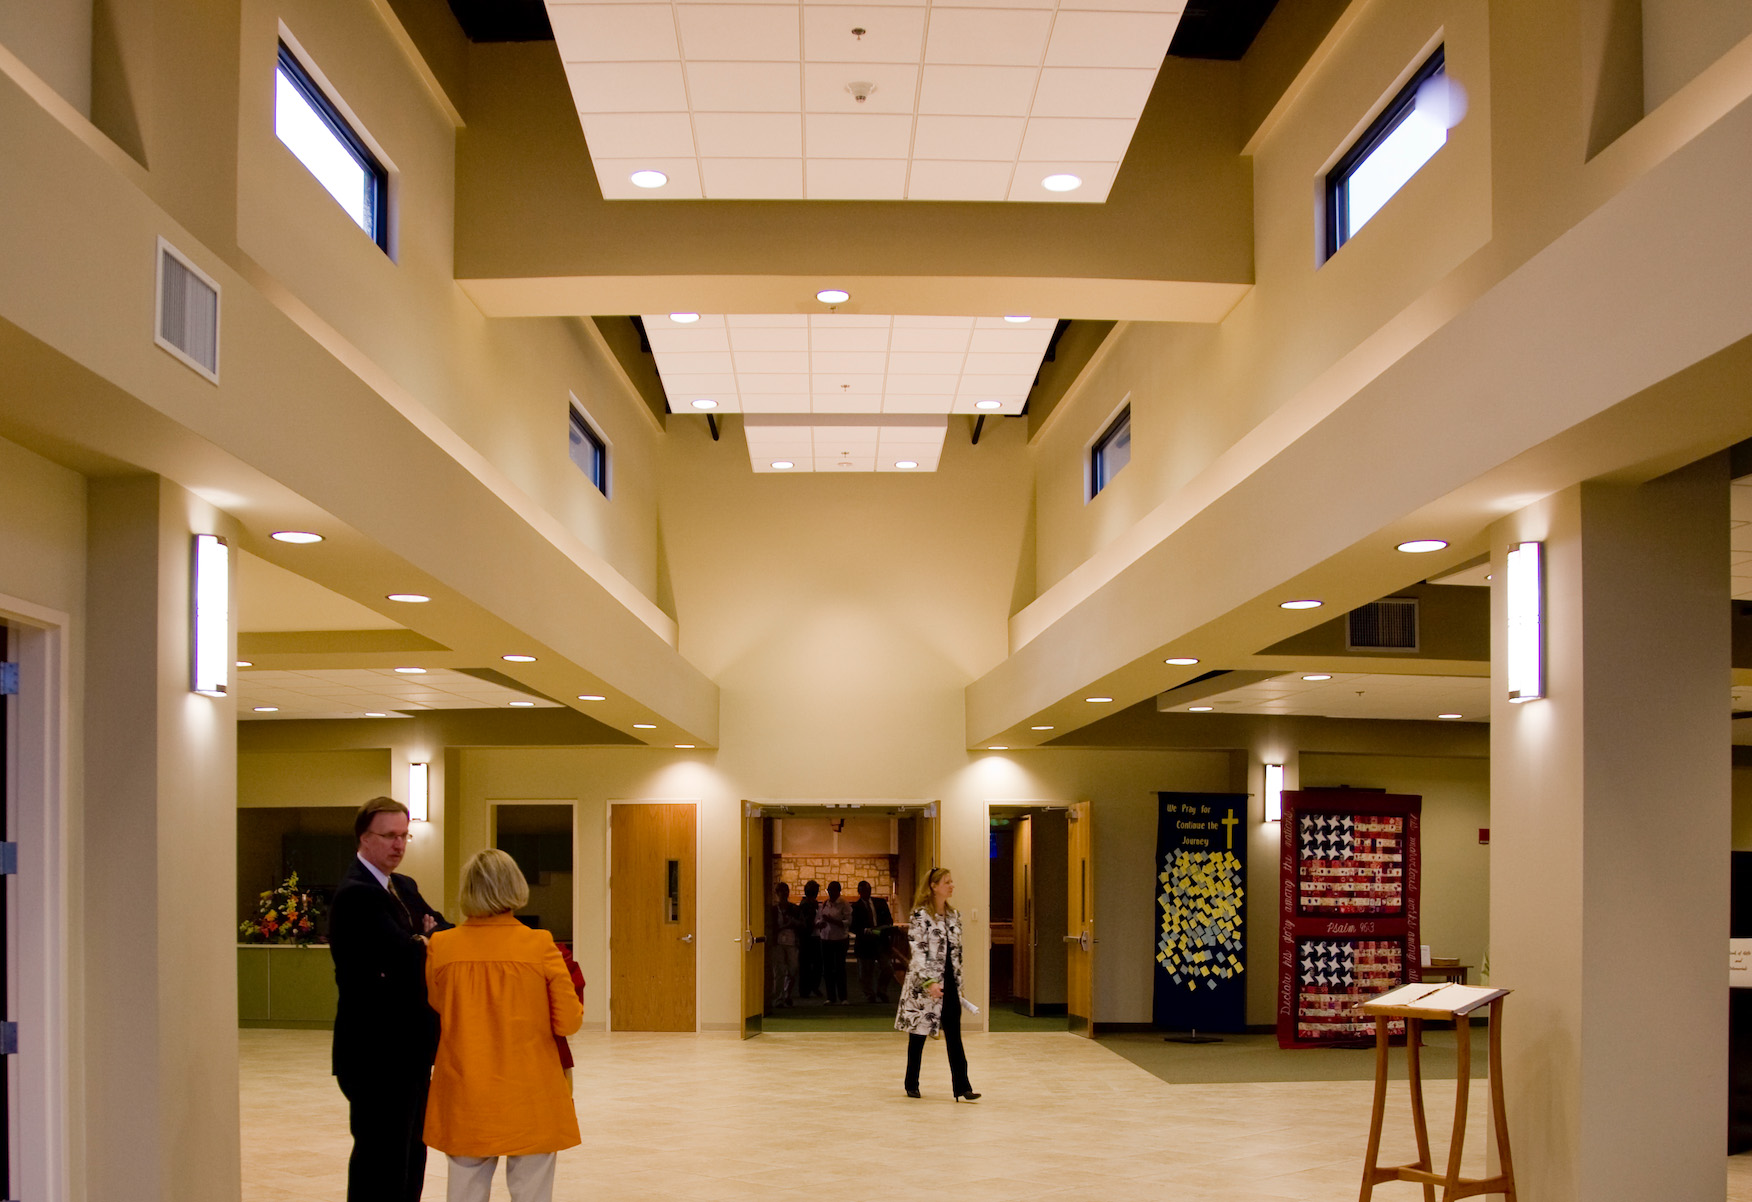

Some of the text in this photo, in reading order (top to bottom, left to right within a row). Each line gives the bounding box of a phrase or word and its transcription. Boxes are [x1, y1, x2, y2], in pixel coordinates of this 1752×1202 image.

[1166, 803, 1211, 815] We Pray for
[1176, 819, 1219, 830] Continue the
[1181, 835, 1209, 847] Journey
[1282, 854, 1293, 874] the
[1284, 878, 1296, 913] among
[1282, 919, 1296, 944] glory
[1327, 921, 1357, 933] Psalm
[1406, 930, 1417, 963] among
[1280, 972, 1292, 1016] Declare
